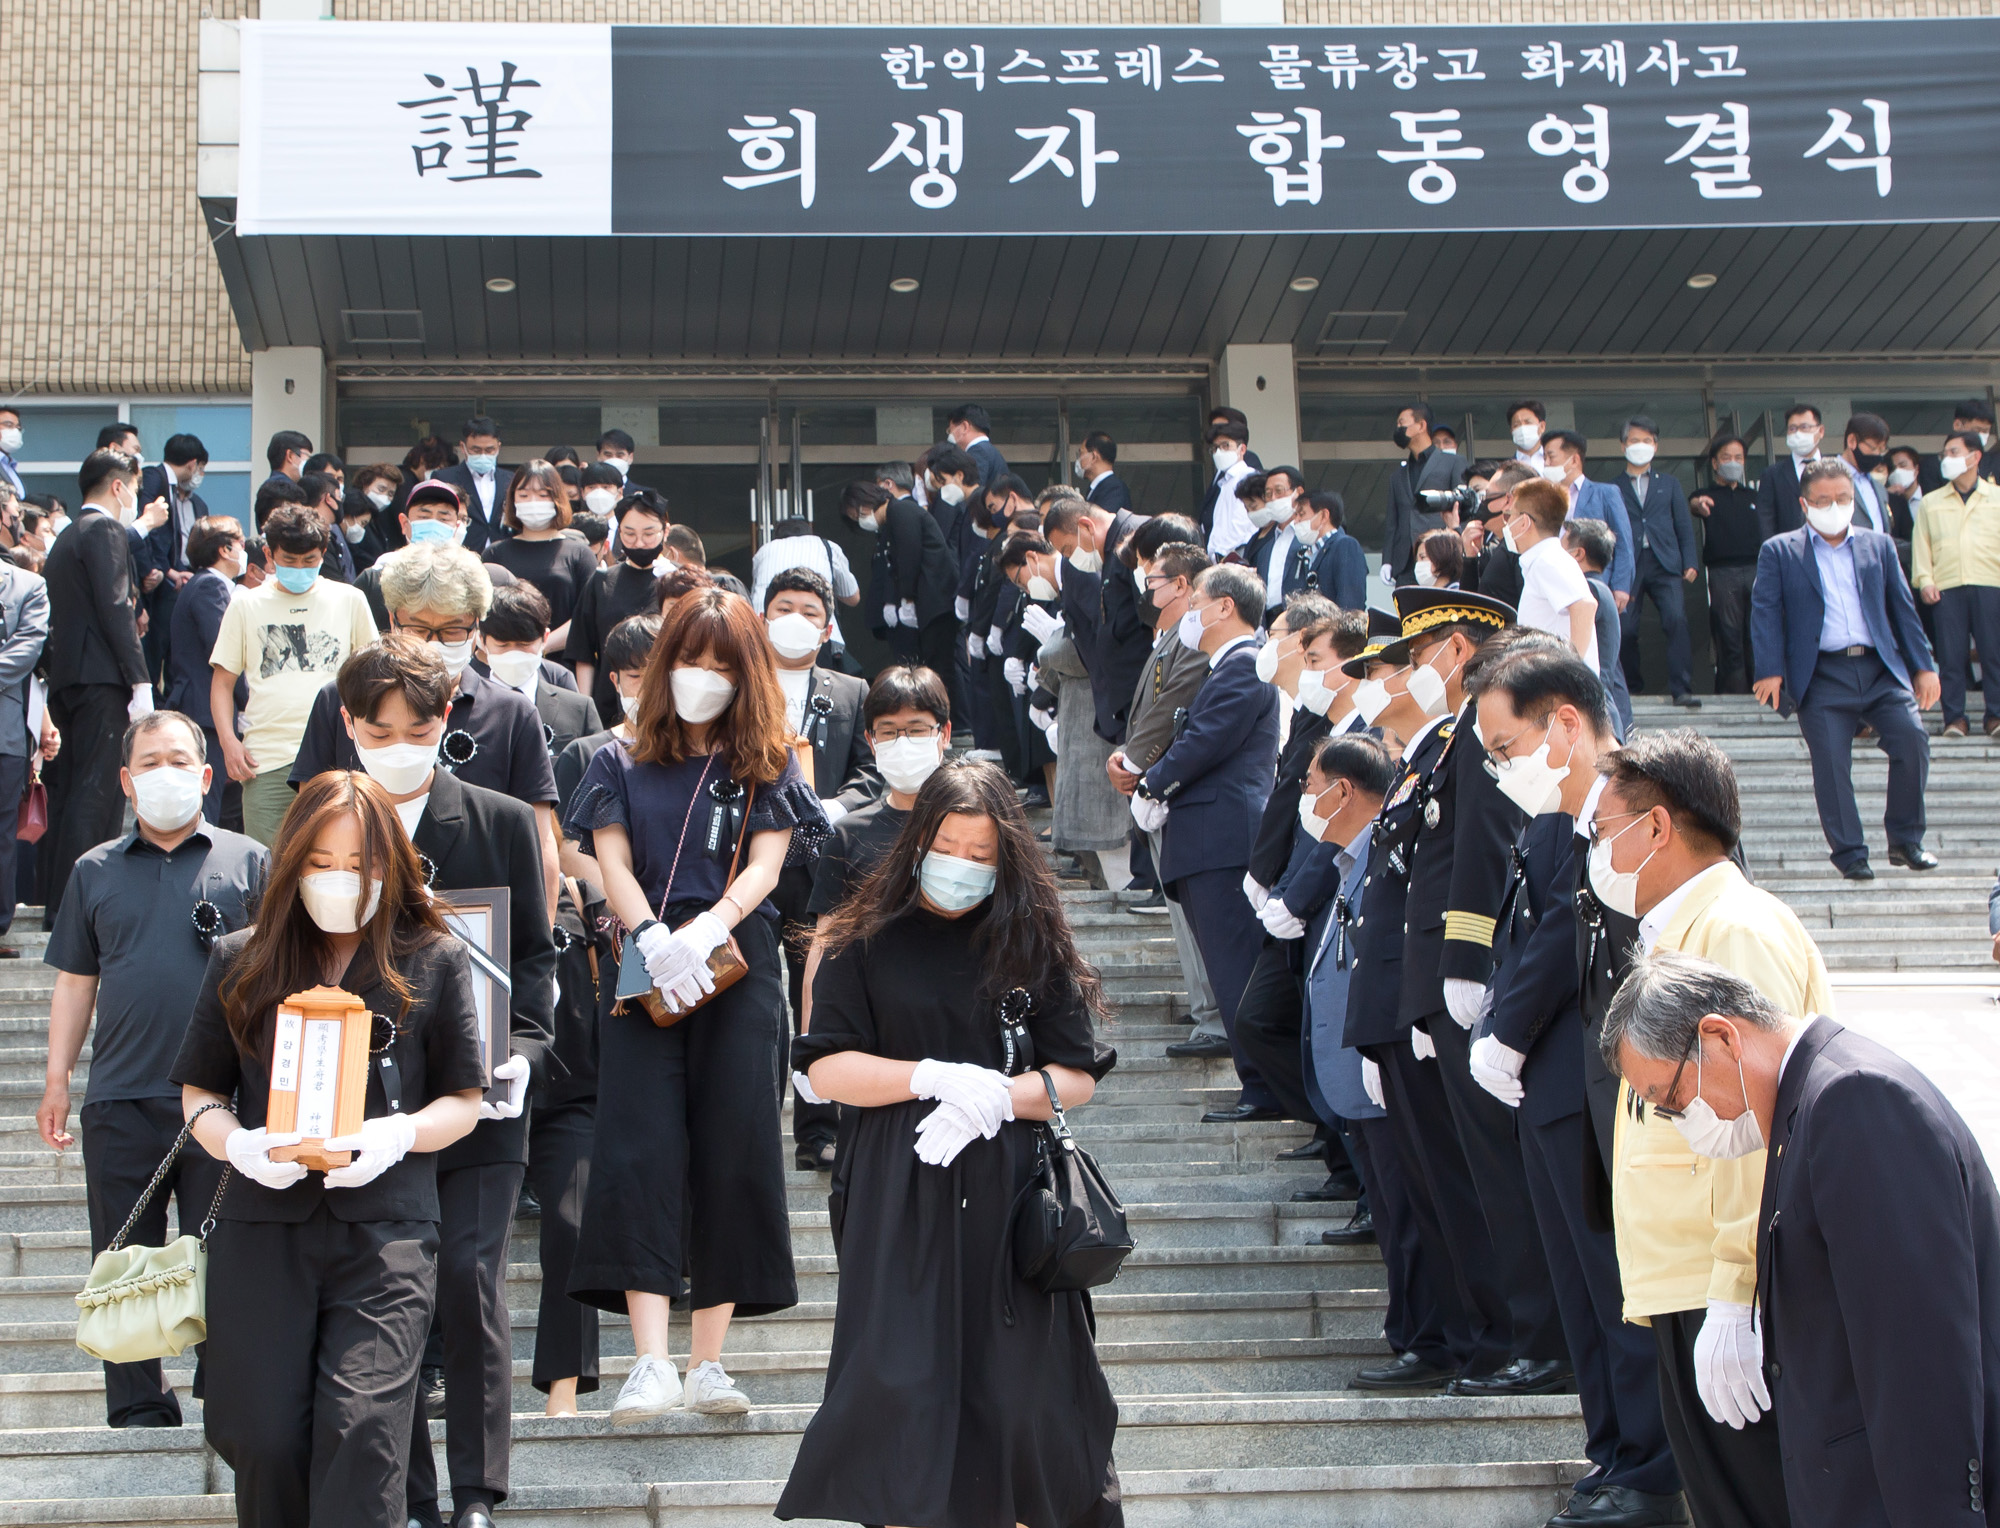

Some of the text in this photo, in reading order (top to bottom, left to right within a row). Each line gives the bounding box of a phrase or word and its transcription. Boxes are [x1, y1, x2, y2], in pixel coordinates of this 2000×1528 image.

[881, 39, 1747, 91] 한익스프레스 물류창고 화재사고
[397, 61, 543, 183] 謹
[722, 98, 1893, 209] 희생자 합동영결식
